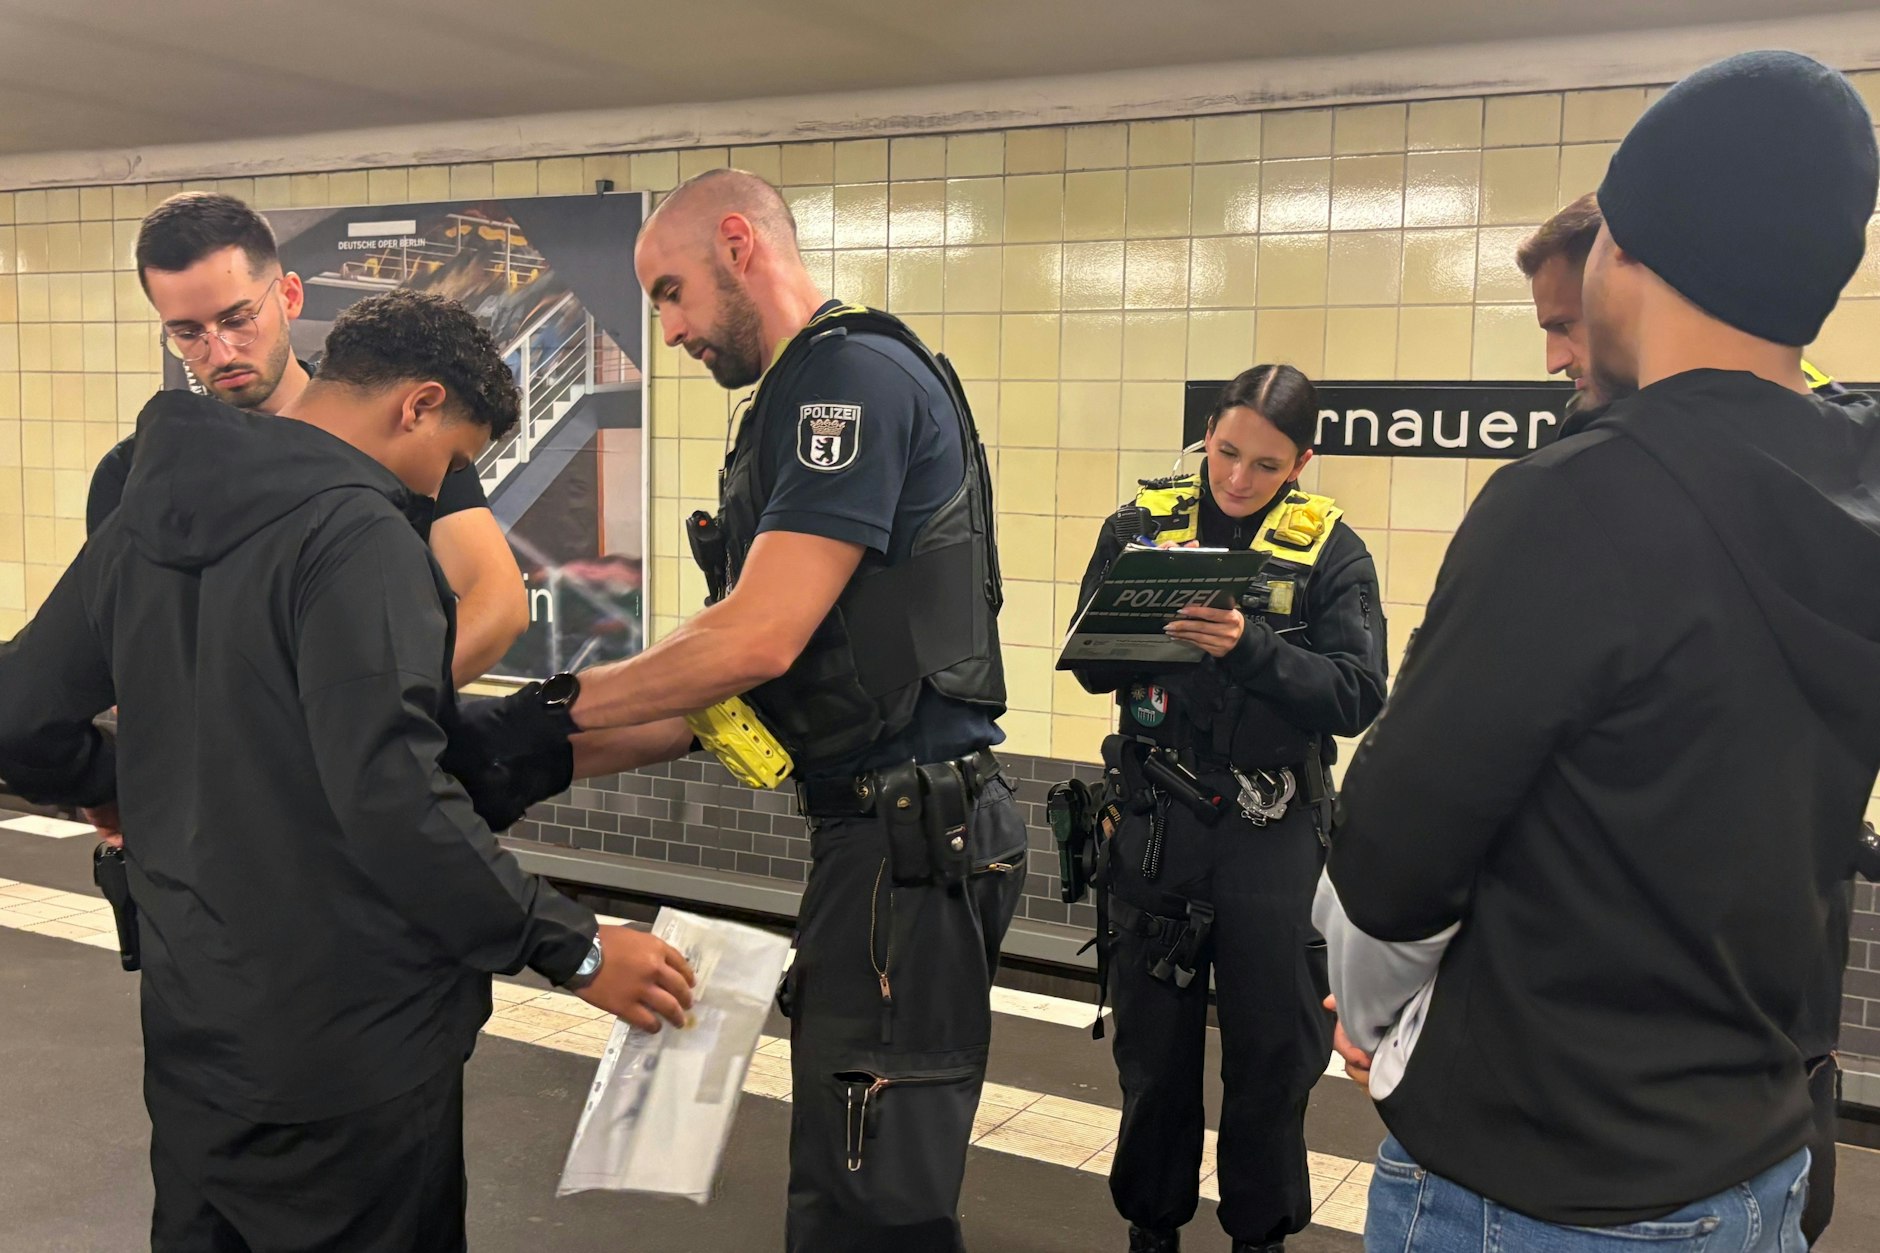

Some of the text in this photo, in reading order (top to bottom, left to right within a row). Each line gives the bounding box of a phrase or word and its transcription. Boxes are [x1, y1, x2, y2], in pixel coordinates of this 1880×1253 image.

[338, 238, 426, 250] DEUTSCHE OPER BERLIN
[803, 406, 856, 421] POLIZEI
[1314, 408, 1557, 449] rnauer
[1112, 588, 1222, 608] POLIZEI
